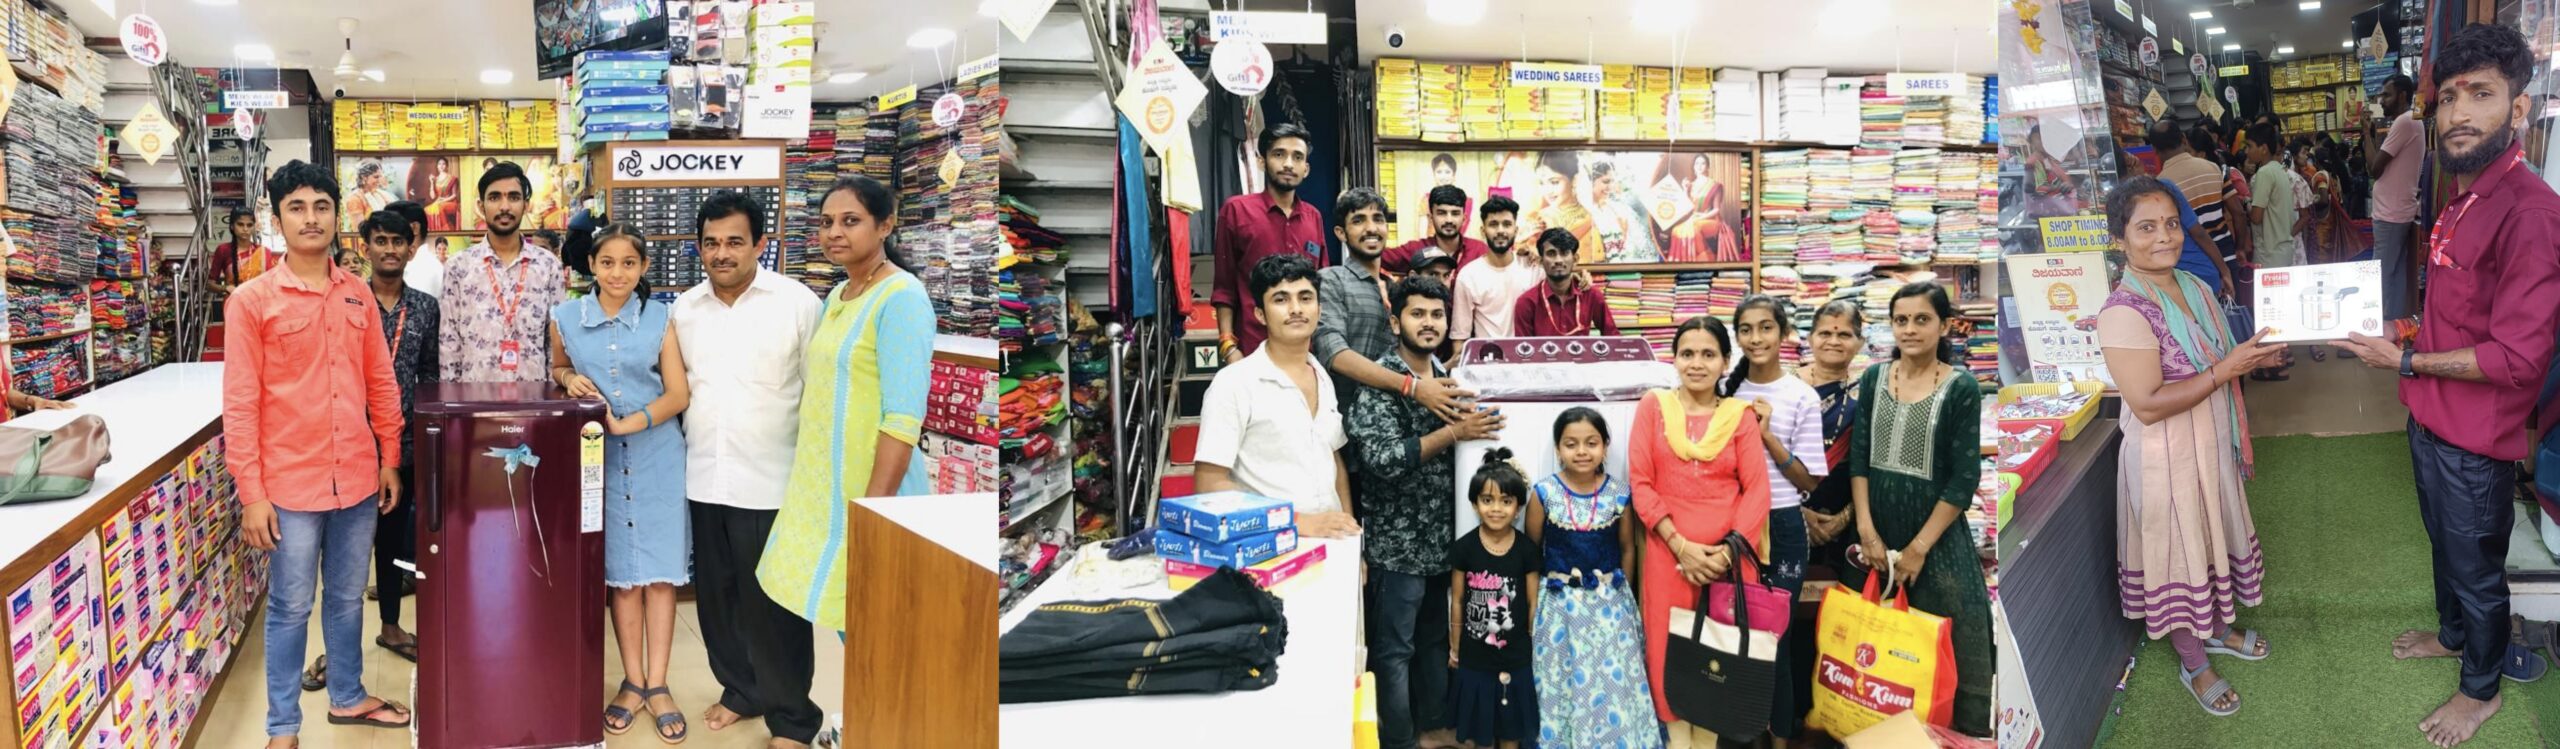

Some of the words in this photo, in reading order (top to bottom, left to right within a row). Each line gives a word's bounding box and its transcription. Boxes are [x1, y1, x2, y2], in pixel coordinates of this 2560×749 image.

[133, 22, 157, 42] 100%
[983, 59, 998, 70] WEA
[1515, 70, 1560, 81] WEDDING
[1564, 71, 1600, 83] SAREES
[1906, 79, 1949, 89] SAREES
[409, 112, 437, 120] WEDDING
[761, 108, 794, 116] JOCKEY
[650, 154, 744, 171] JOCKEY
[2049, 220, 2072, 232] SHOP
[2047, 235, 2077, 248] 8.00AM
[2080, 236, 2088, 246] to
[501, 425, 525, 433] Haier
[1466, 602, 1498, 622] STYLE
[1822, 660, 1854, 688] Kum
[1865, 681, 1912, 708] Kum
[1841, 689, 1878, 710] FASHIONS
